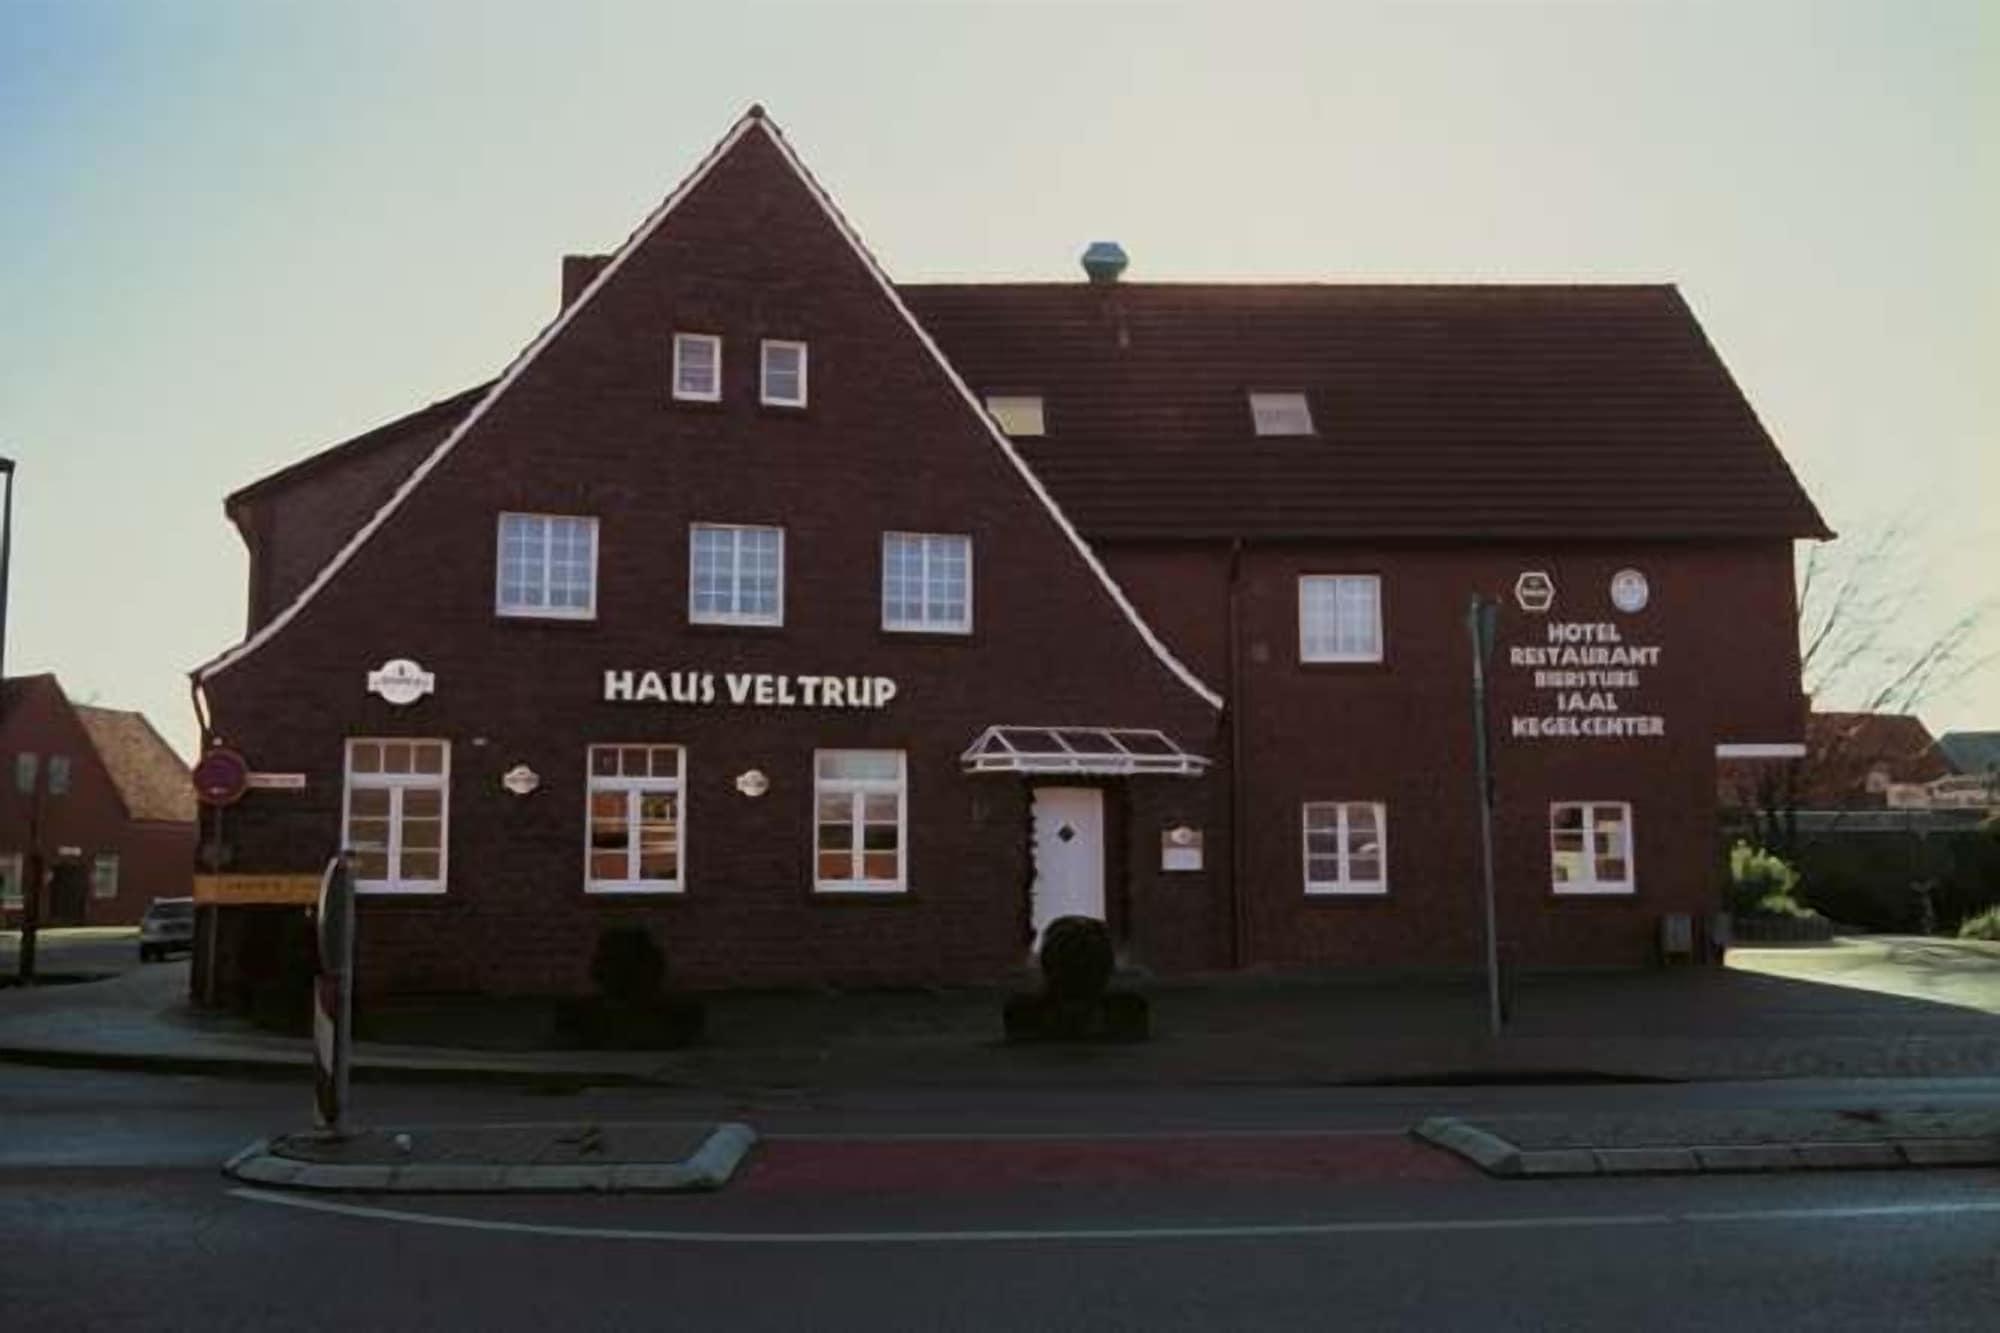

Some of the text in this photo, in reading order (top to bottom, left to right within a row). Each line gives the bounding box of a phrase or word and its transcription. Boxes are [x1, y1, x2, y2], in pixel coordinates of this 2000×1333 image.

[1547, 623, 1622, 643] HOTEL
[1510, 646, 1661, 667] RESTAURANT
[604, 670, 897, 707] HAUS VELTRUP
[1511, 716, 1665, 737] KEGELCENTER
